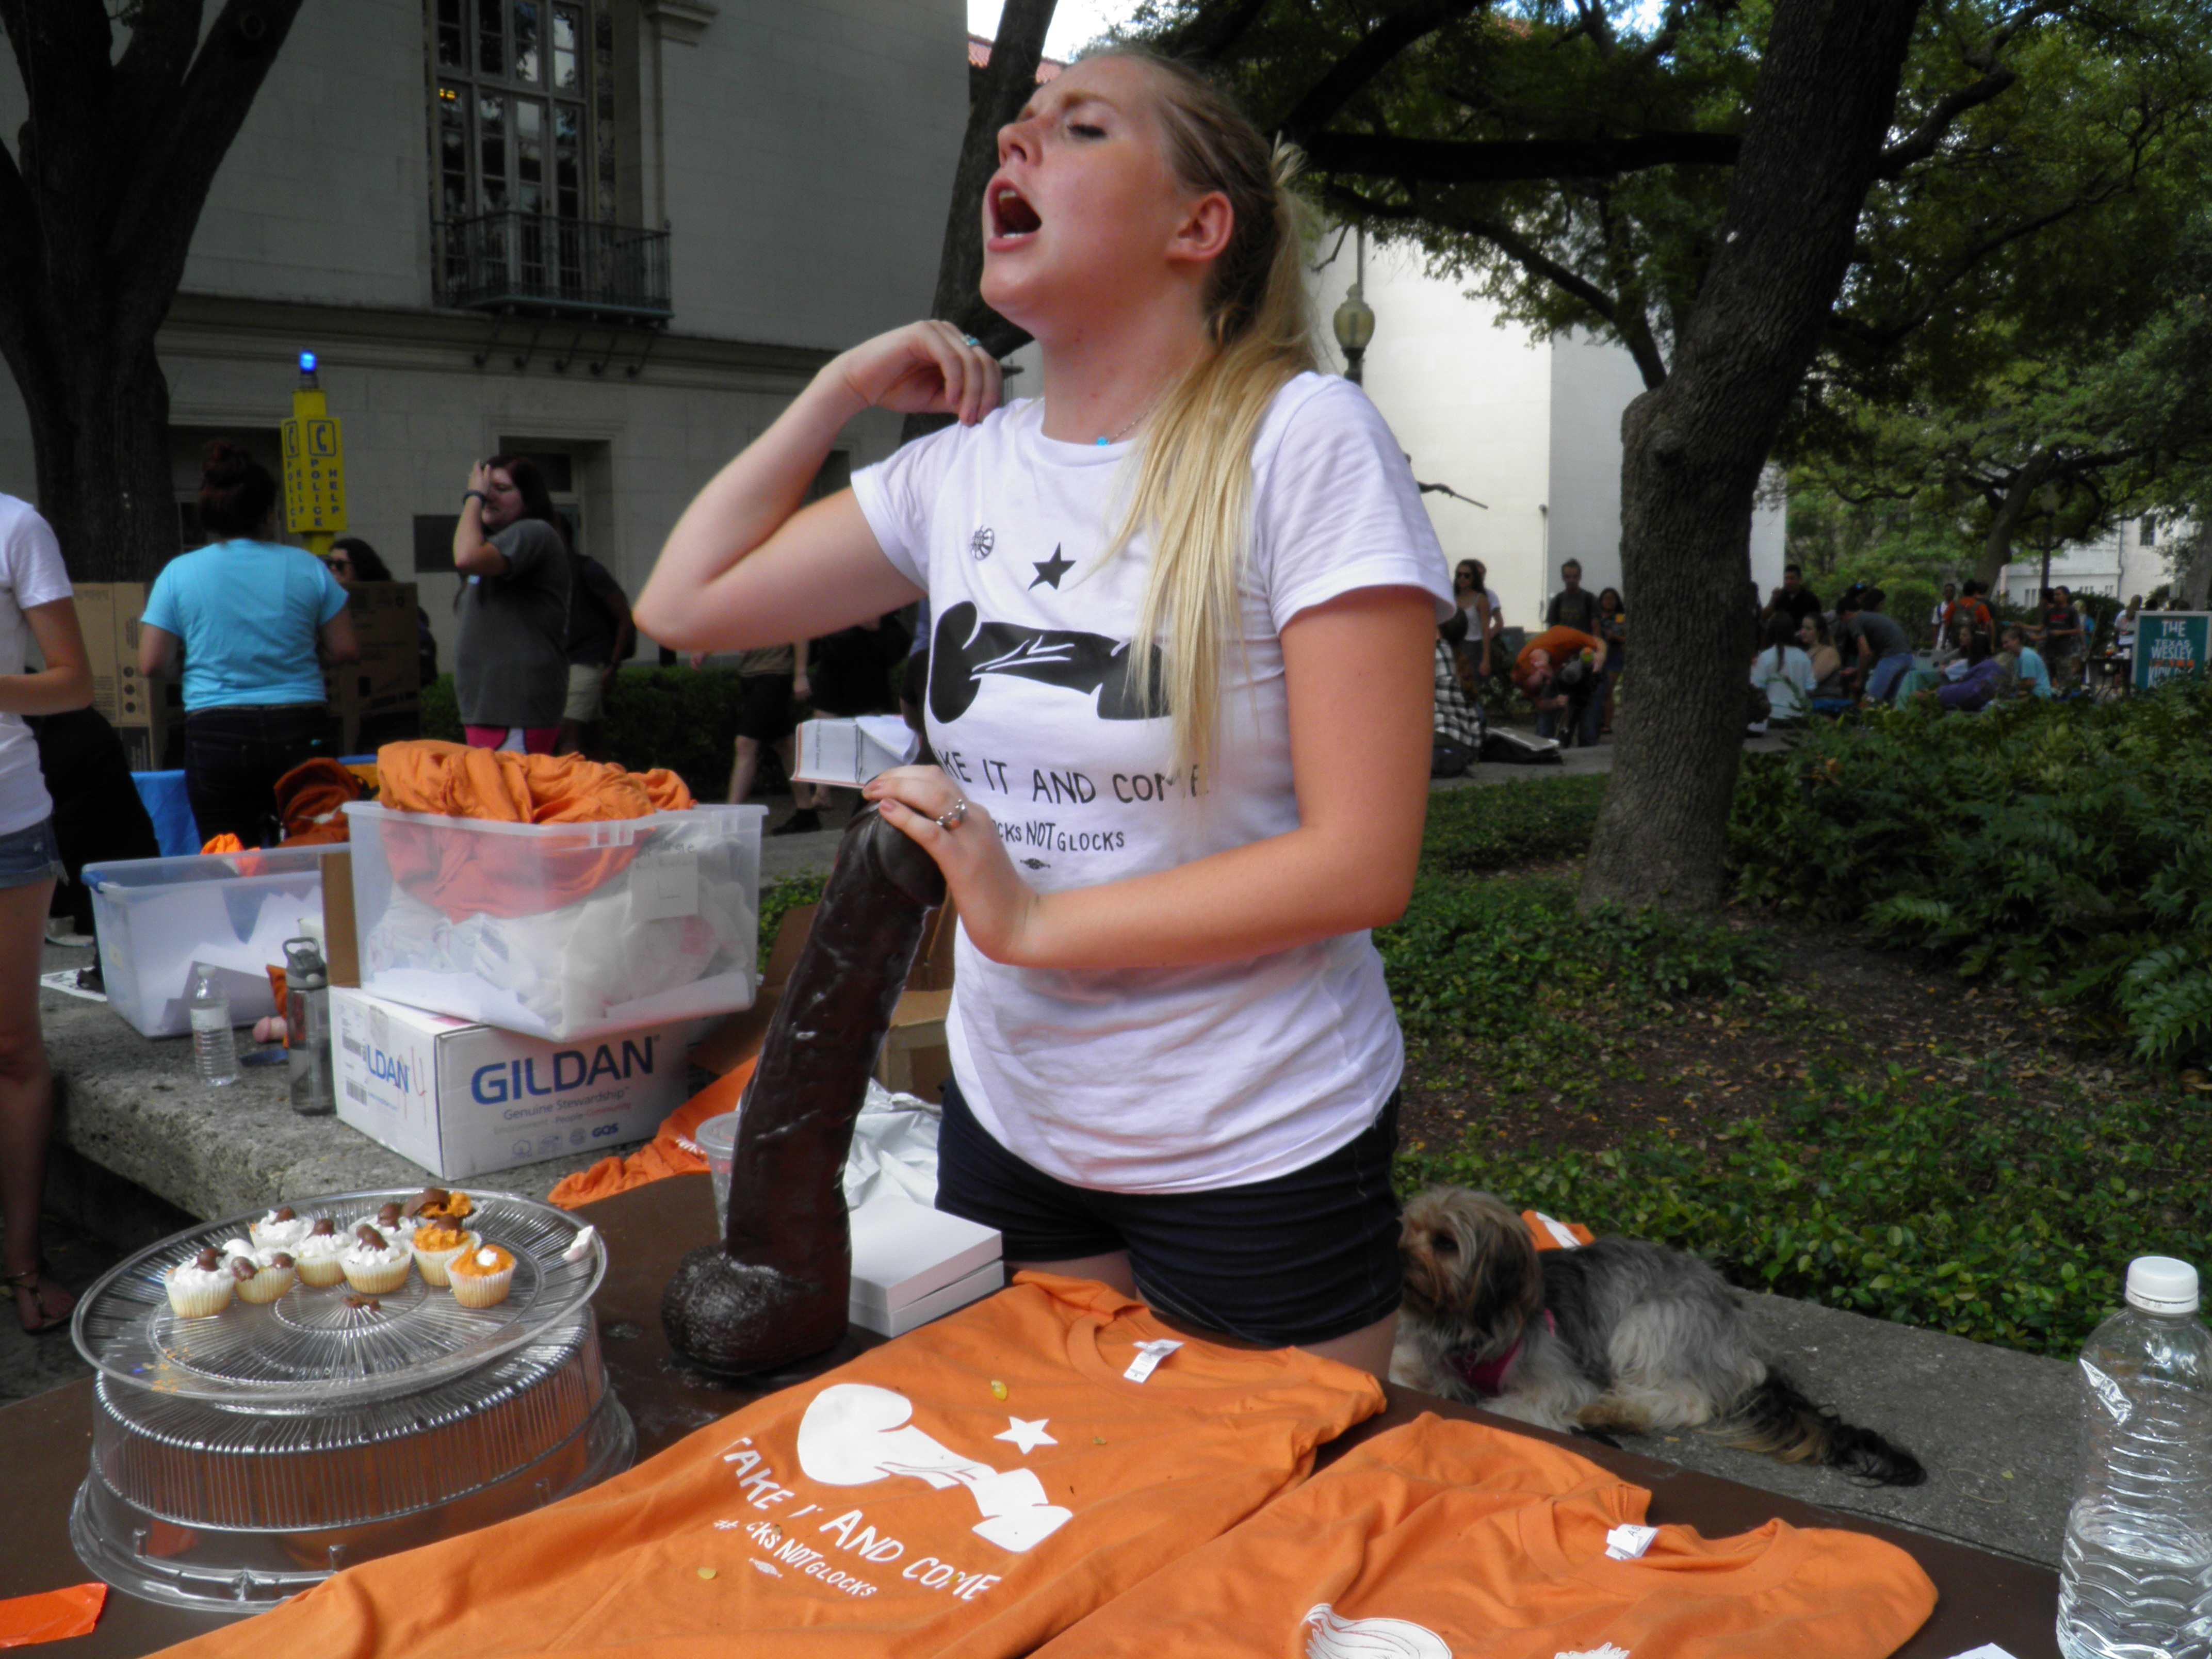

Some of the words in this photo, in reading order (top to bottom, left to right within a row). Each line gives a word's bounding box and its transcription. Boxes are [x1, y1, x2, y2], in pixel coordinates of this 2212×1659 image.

[311, 459, 322, 527] POLICE
[329, 469, 339, 514] HELP
[2155, 639, 2190, 647] TEXAS
[2161, 620, 2187, 638] THE
[2151, 646, 2193, 660] WESLEY
[982, 758, 1009, 794] IT
[1032, 769, 1096, 804] AND
[1026, 820, 1056, 851] NOT
[1056, 831, 1125, 853] GLOCKS
[471, 1036, 654, 1105] GILDAN
[503, 1102, 554, 1120] Genuine
[556, 1089, 624, 1110] Stewardship
[773, 1537, 824, 1568] NOT
[805, 1561, 877, 1596] GLOCKS
[818, 1509, 904, 1562] AND
[902, 1557, 1002, 1600] COME
